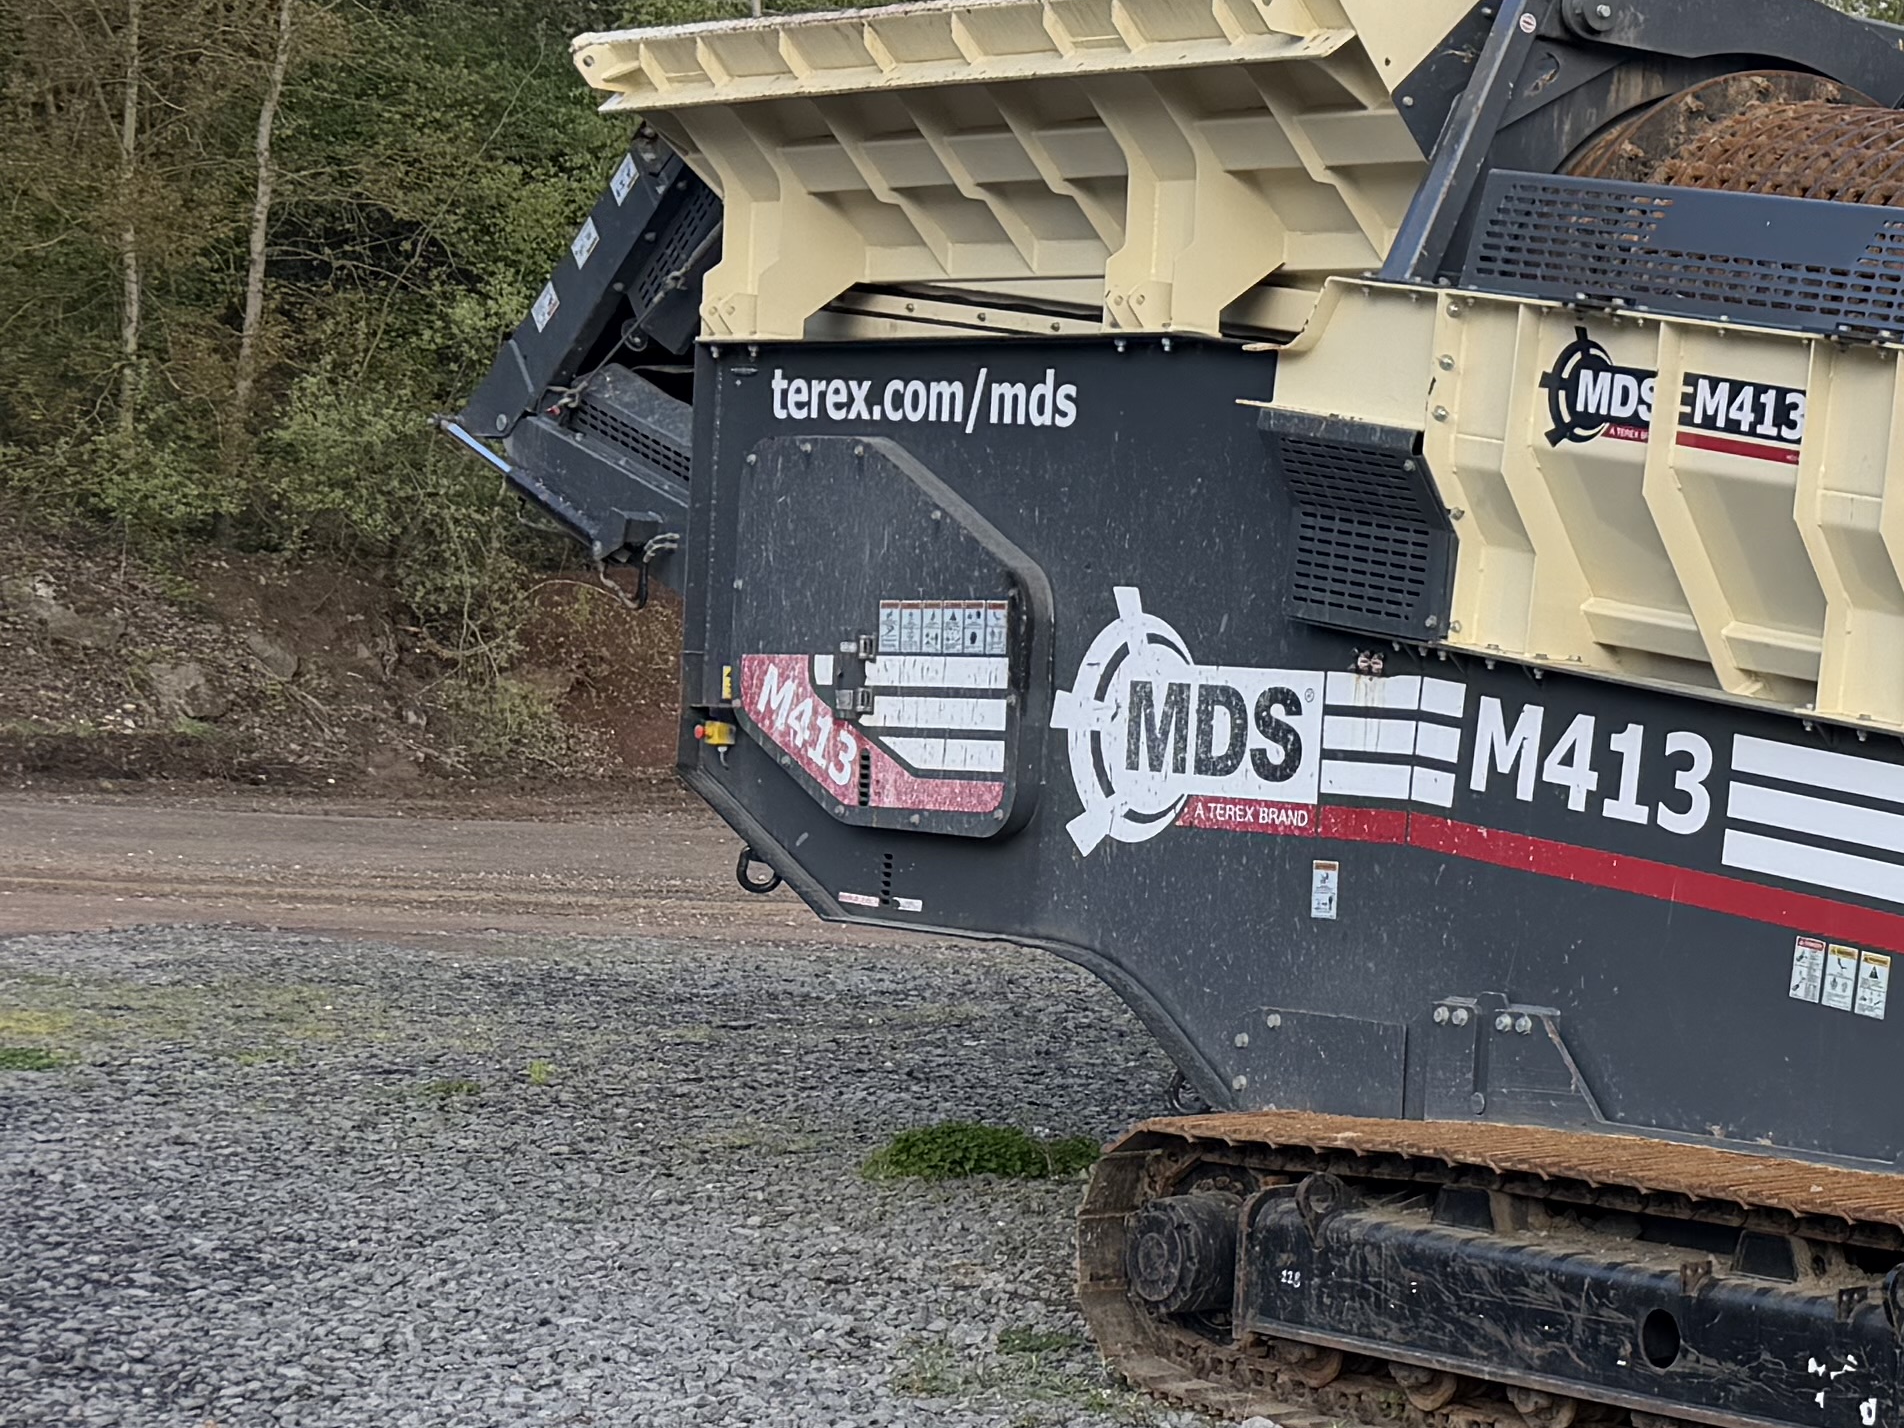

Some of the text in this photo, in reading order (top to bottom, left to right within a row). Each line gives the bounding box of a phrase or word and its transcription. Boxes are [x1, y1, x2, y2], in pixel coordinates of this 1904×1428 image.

[771, 367, 1078, 434] terex.com/mds
[1575, 368, 1657, 423] MDS
[1693, 378, 1806, 441] M413
[756, 662, 858, 787] M413
[1125, 680, 1303, 783] MDS
[1469, 694, 1714, 836] M413
[1194, 802, 1309, 827] A TEREX BRAND
